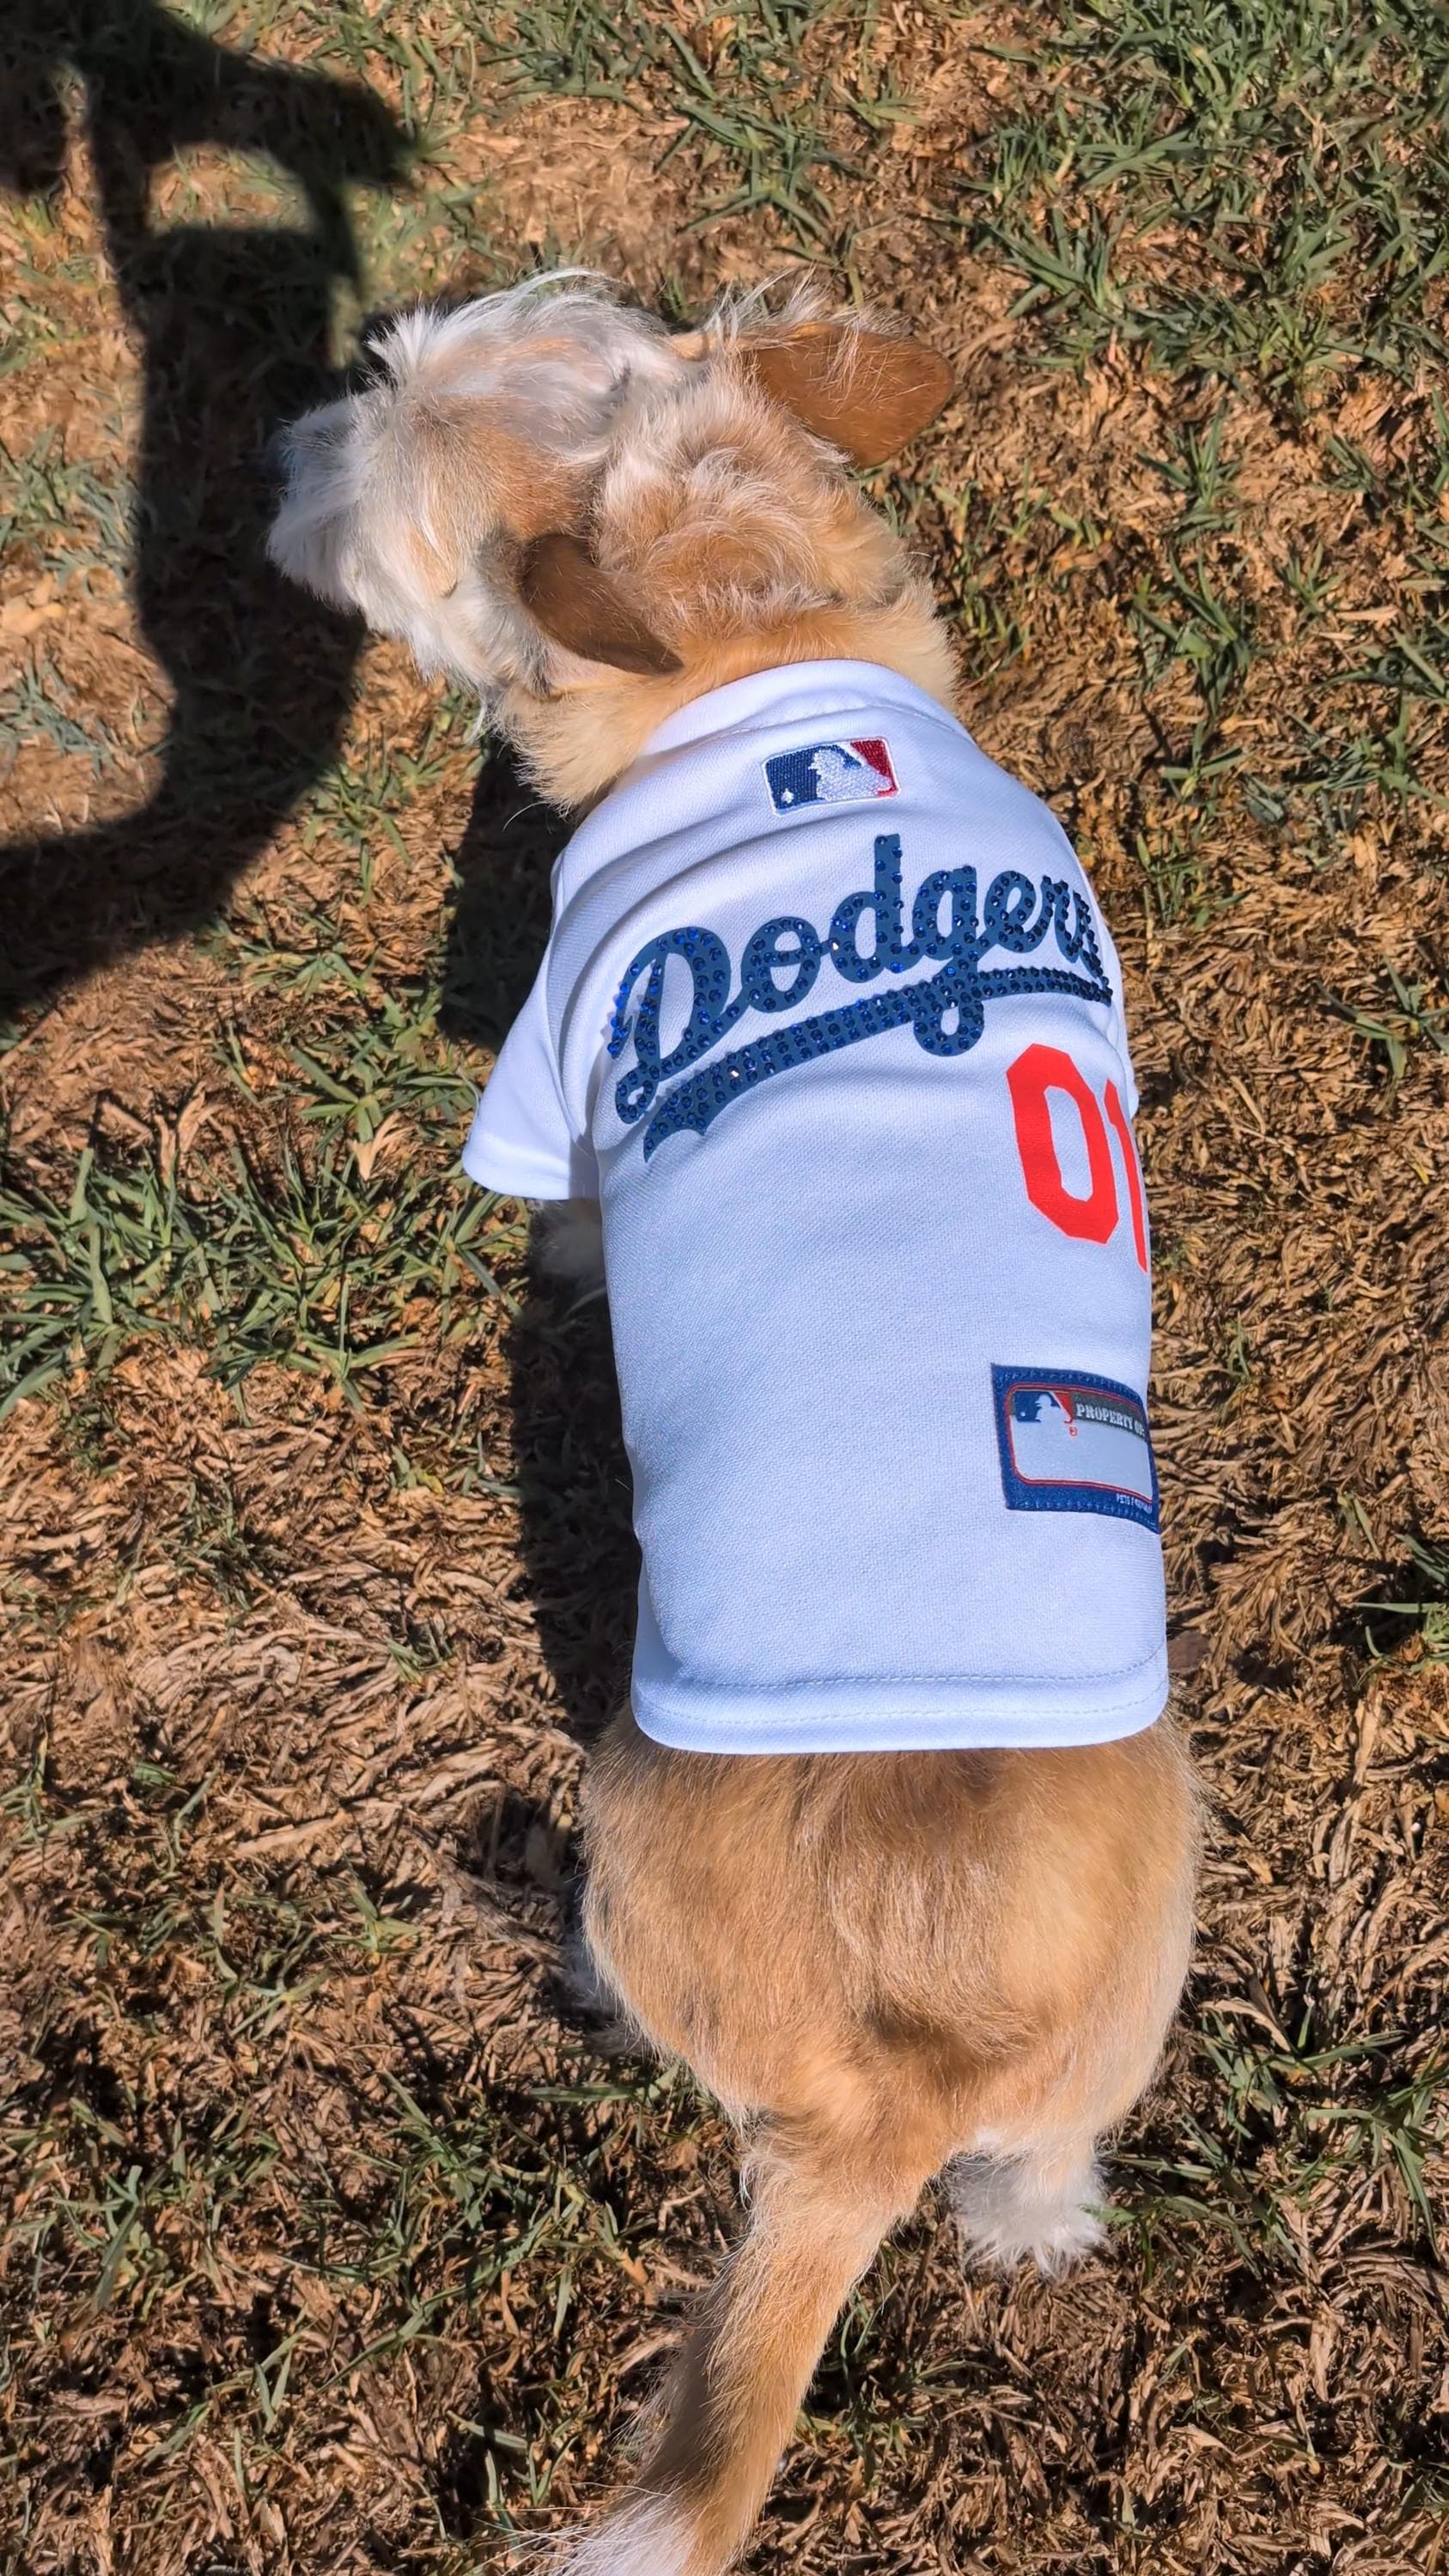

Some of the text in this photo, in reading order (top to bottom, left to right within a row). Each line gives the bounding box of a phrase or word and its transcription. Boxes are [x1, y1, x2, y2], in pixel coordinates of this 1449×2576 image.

[607, 833, 1114, 1127] Dodgers
[1006, 1042, 1148, 1275] 01
[1075, 1402, 1133, 1431] PROPERTY
